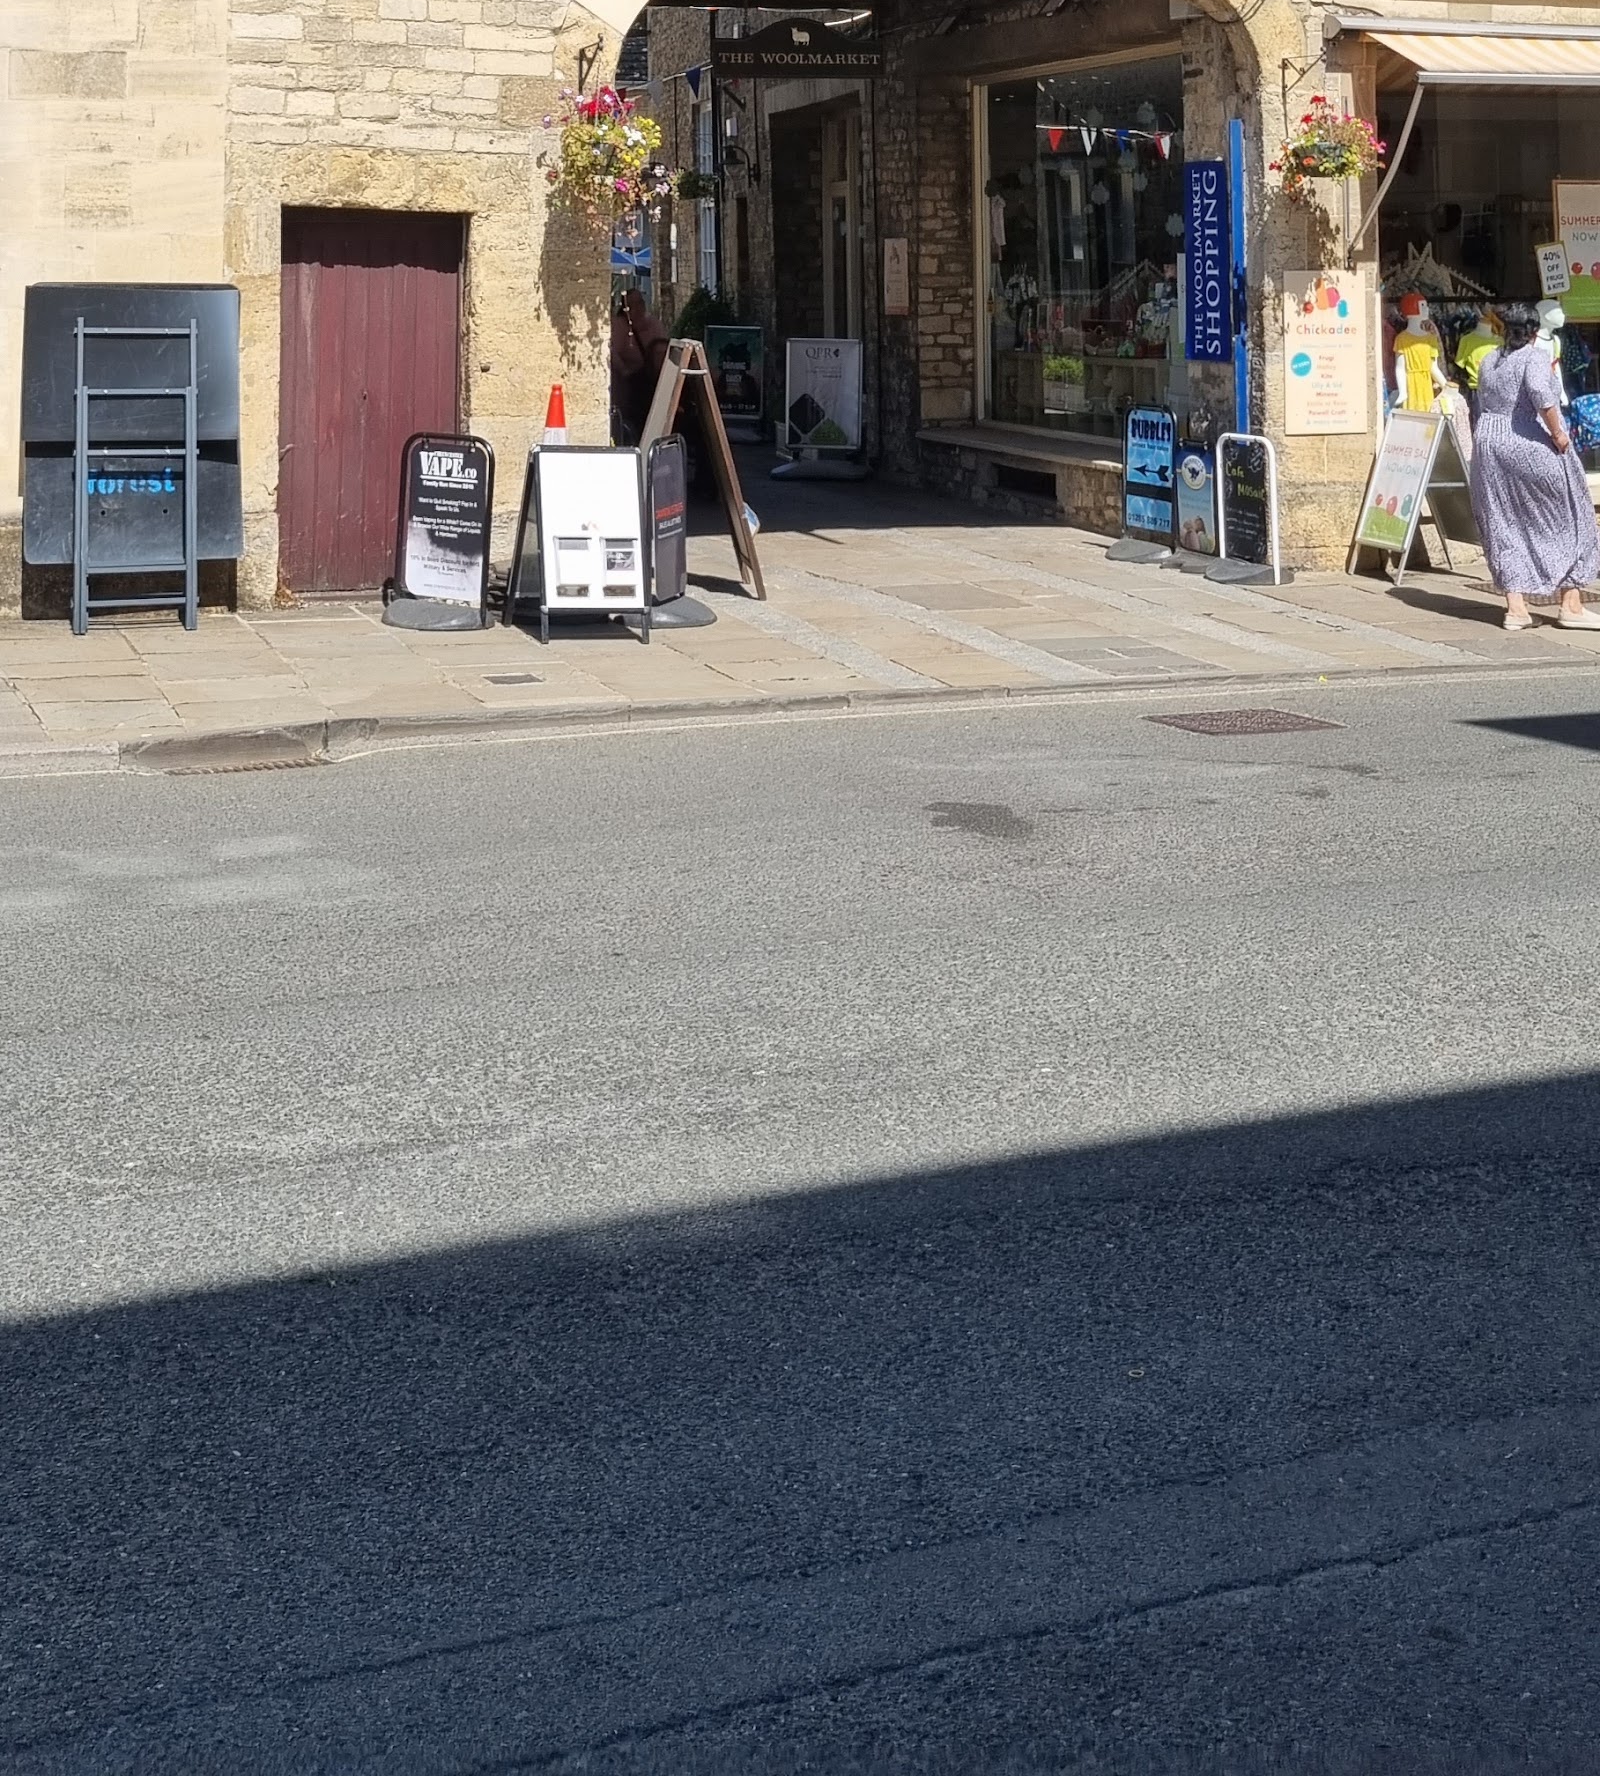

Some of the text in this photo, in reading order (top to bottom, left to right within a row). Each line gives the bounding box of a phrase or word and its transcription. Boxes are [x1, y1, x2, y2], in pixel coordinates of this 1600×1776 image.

[718, 52, 881, 65] THE WOOLMARKET
[1572, 232, 1599, 242] NOW
[1191, 169, 1204, 353] THE WOOLMARKET
[1203, 169, 1222, 355] SHOPPING
[1543, 250, 1561, 261] 40%
[1547, 264, 1560, 273] OFF
[1552, 282, 1565, 290] KITE
[1296, 323, 1357, 335] Chickadee
[805, 346, 833, 360] QPR
[1130, 417, 1171, 443] BUBBLES
[1384, 443, 1413, 457] SUMMER
